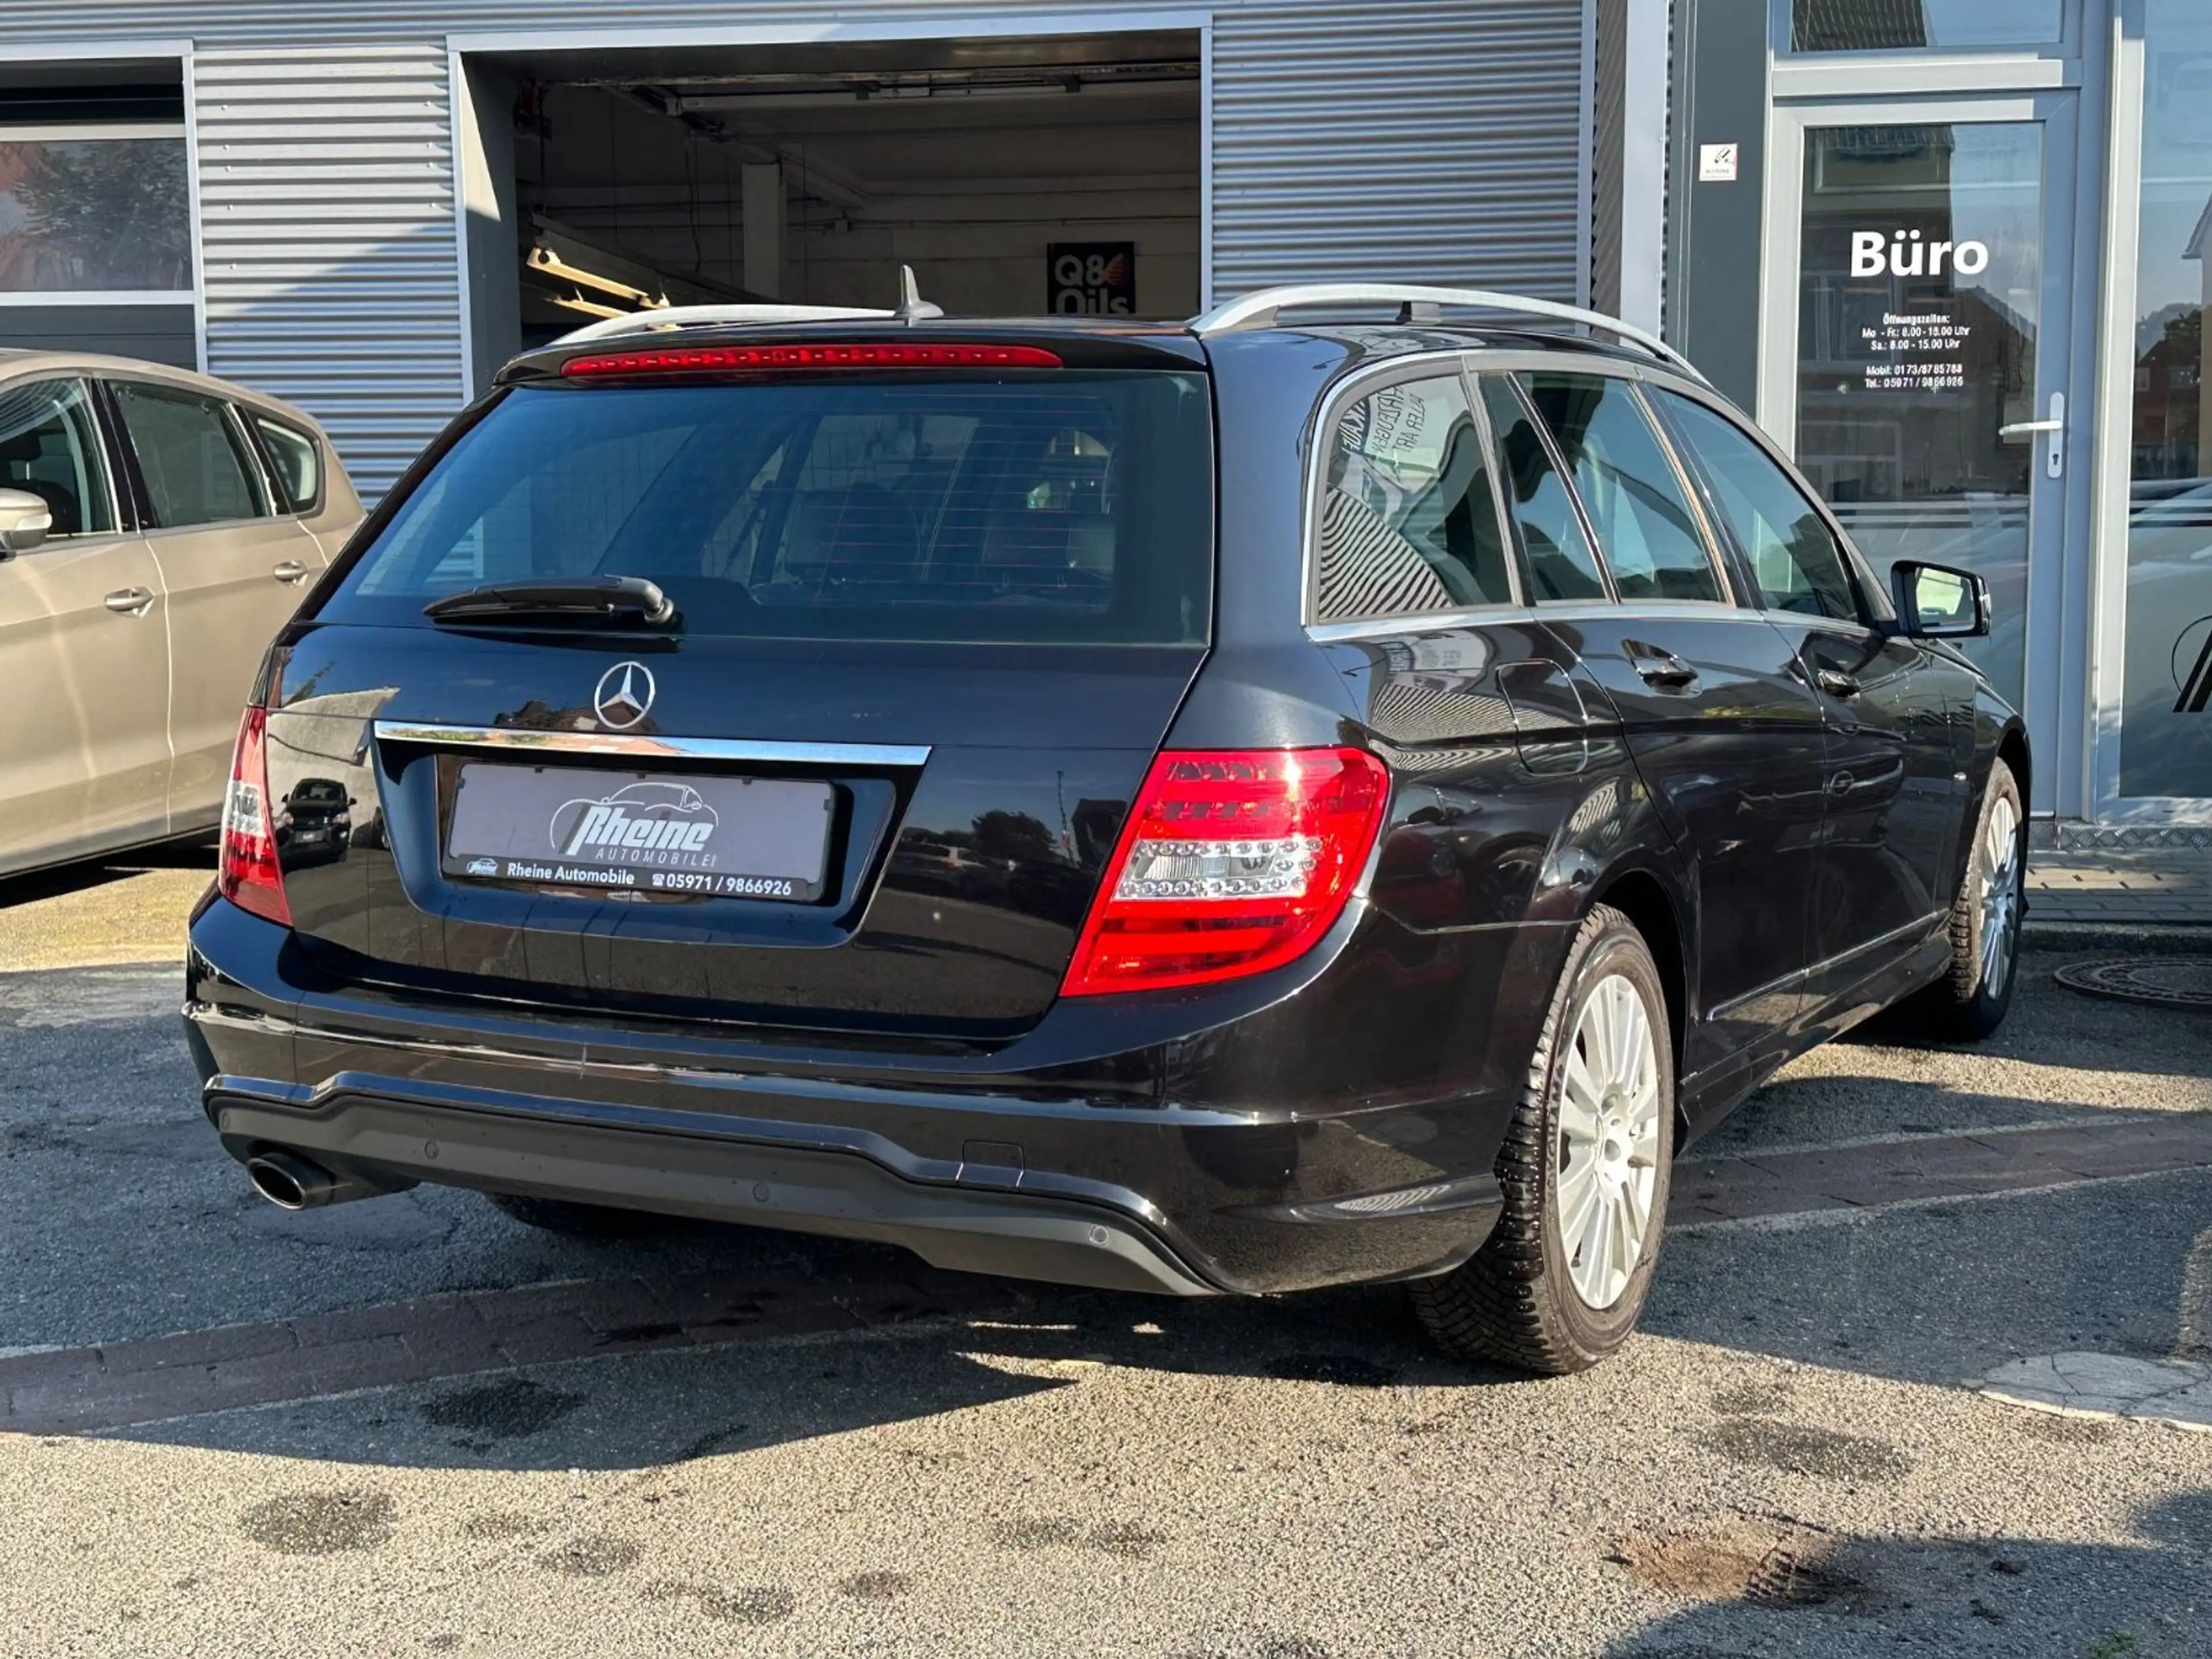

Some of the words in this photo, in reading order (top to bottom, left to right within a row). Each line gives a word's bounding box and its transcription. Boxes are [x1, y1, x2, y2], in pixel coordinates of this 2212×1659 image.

[1850, 229, 1989, 277] Büro
[1055, 254, 1105, 287] Q8
[1056, 288, 1129, 314] Oils
[1945, 339, 1961, 349] Uhr
[1954, 326, 1971, 336] Uhr
[558, 804, 714, 856] Rheine
[507, 862, 552, 879] Rheine
[554, 866, 635, 885] Automobile
[666, 873, 712, 891] 05971
[715, 876, 724, 892] /
[726, 877, 792, 896] 9866926
